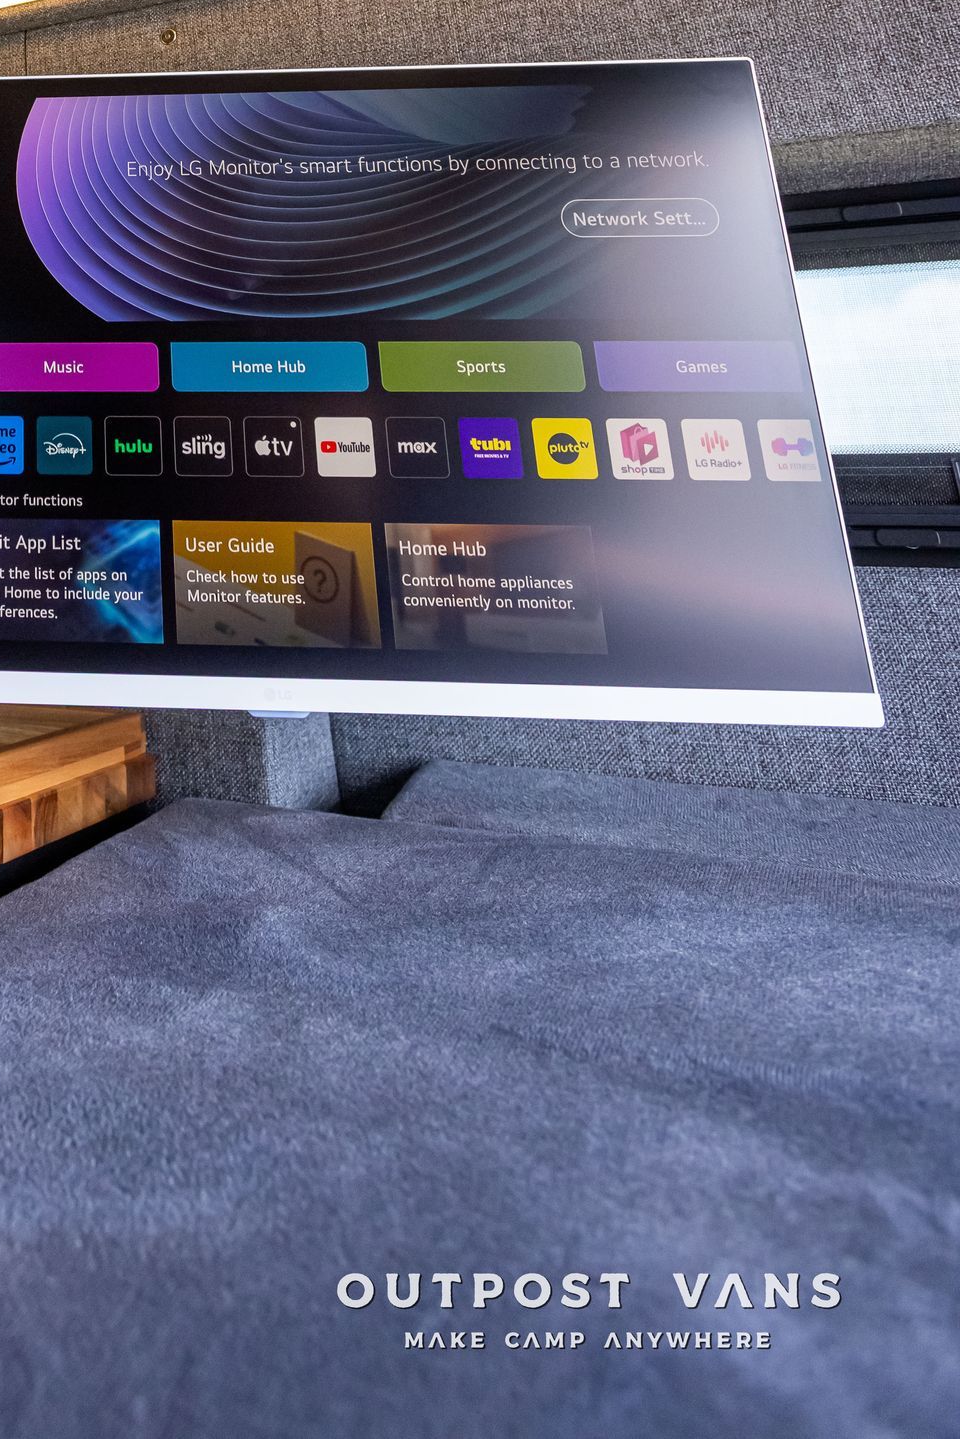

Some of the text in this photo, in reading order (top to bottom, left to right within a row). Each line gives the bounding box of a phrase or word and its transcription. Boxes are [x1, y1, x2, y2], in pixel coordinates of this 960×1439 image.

[127, 150, 710, 180] Enjoy LG Monitor's smart functions by connecting to a network.
[573, 211, 648, 226] Network
[43, 361, 84, 373] Music
[232, 360, 306, 373] Home Hub
[456, 360, 506, 376] Sports
[675, 360, 728, 373] Games
[115, 439, 153, 453] hulu
[182, 435, 226, 459] sling
[271, 438, 293, 456] tv
[338, 441, 370, 453] YouTube
[398, 441, 437, 453] max
[470, 438, 511, 451] tubi
[549, 442, 580, 455] pluto
[621, 464, 648, 476] shop
[695, 459, 742, 469] LG Radio+
[23, 494, 83, 507] functions
[15, 535, 47, 554] App
[52, 535, 82, 551] List
[185, 537, 275, 553] User Guide
[399, 540, 487, 557] Home Hub
[9, 567, 30, 580] the
[34, 567, 55, 580] list
[59, 568, 73, 580] of
[77, 569, 107, 583] apps
[111, 571, 127, 581] on
[186, 570, 305, 585] Check how to use
[401, 574, 574, 591] Control home appliances
[4, 586, 41, 599] Home
[46, 587, 60, 599] to
[64, 587, 110, 600] include
[114, 589, 143, 603] your
[187, 589, 306, 605] Monitor features.
[403, 594, 576, 611] conveniently on monitor.
